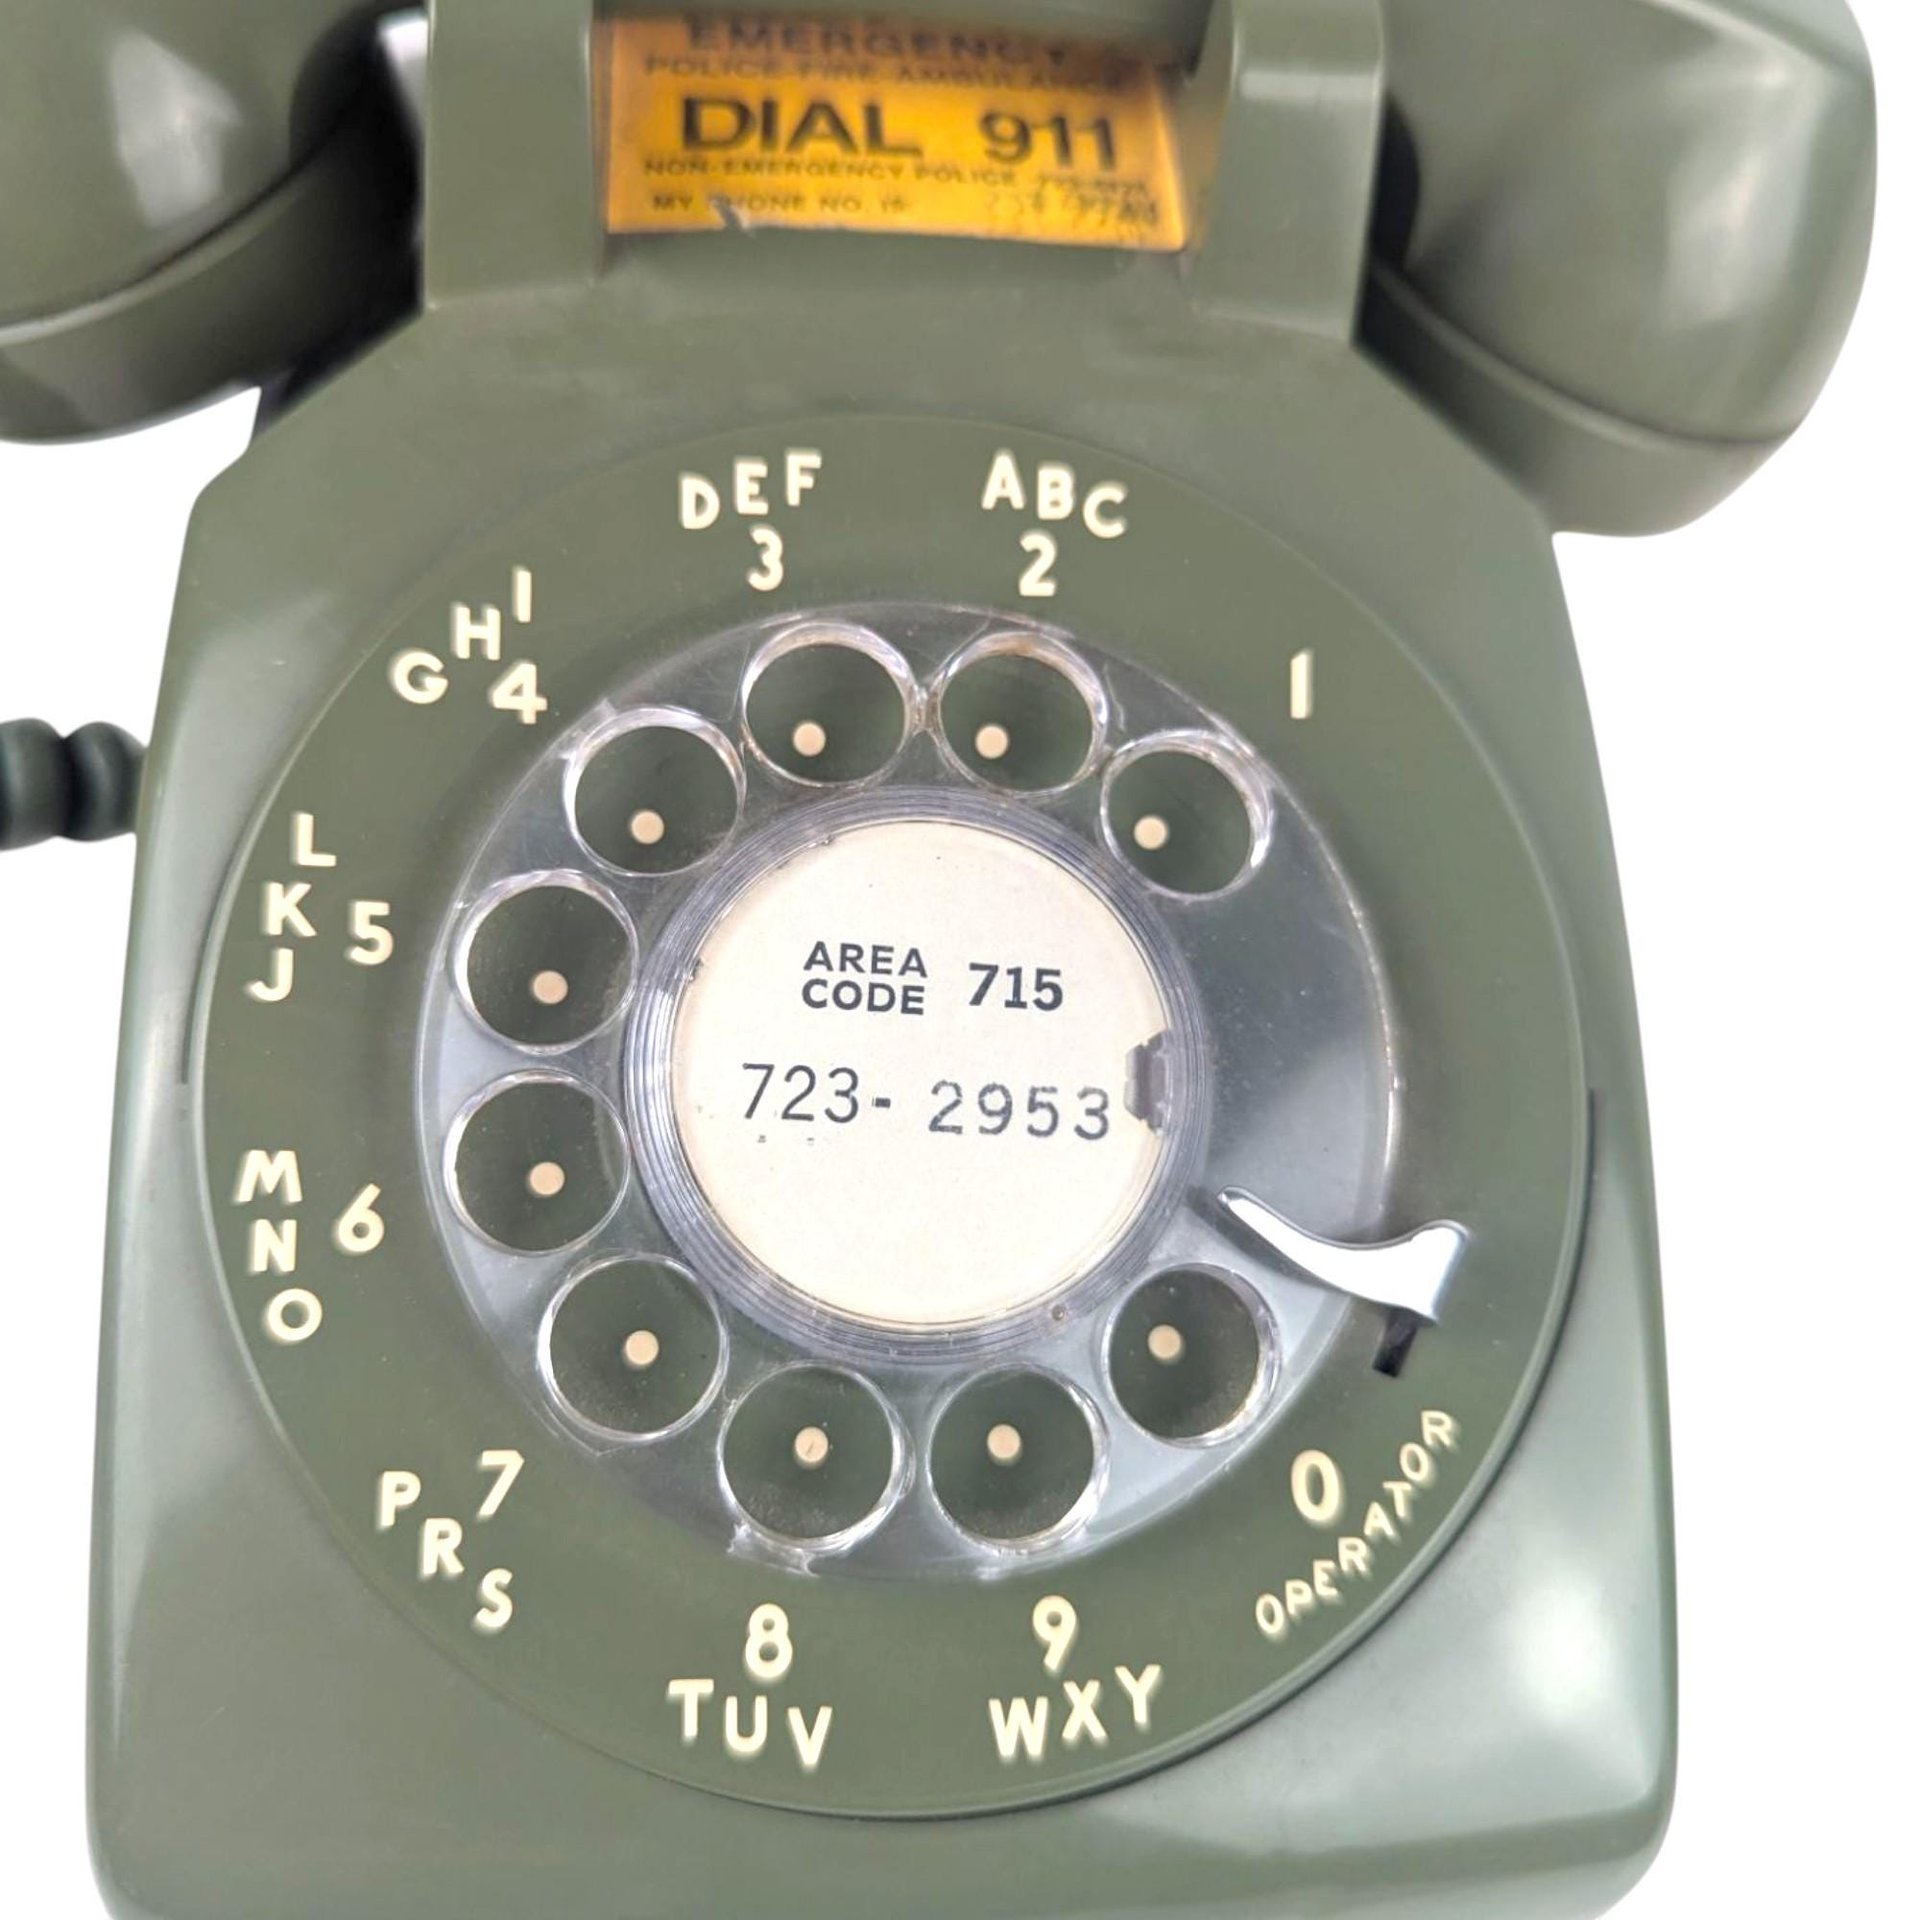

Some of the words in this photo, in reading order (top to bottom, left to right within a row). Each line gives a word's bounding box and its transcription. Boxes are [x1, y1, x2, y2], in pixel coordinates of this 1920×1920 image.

[682, 96, 922, 158] DIAL
[981, 111, 1118, 171] 911
[654, 194, 694, 212] MY
[914, 164, 1018, 188] POLICE
[748, 525, 784, 592] 3
[1019, 530, 1057, 597] 2
[490, 660, 548, 724] 4
[1290, 650, 1312, 720] 1
[347, 900, 393, 966] 5
[803, 940, 928, 978] AREA
[801, 978, 925, 1016] CODE
[969, 962, 1064, 1012] 715
[742, 1062, 891, 1124] 723-
[928, 1079, 1110, 1141] 2953
[334, 1183, 385, 1254] 6
[477, 1449, 525, 1519] 7
[1290, 1449, 1343, 1525] 0
[1255, 1410, 1457, 1636] OPERATOR
[743, 1602, 794, 1681] 8
[1032, 1595, 1078, 1672] 9
